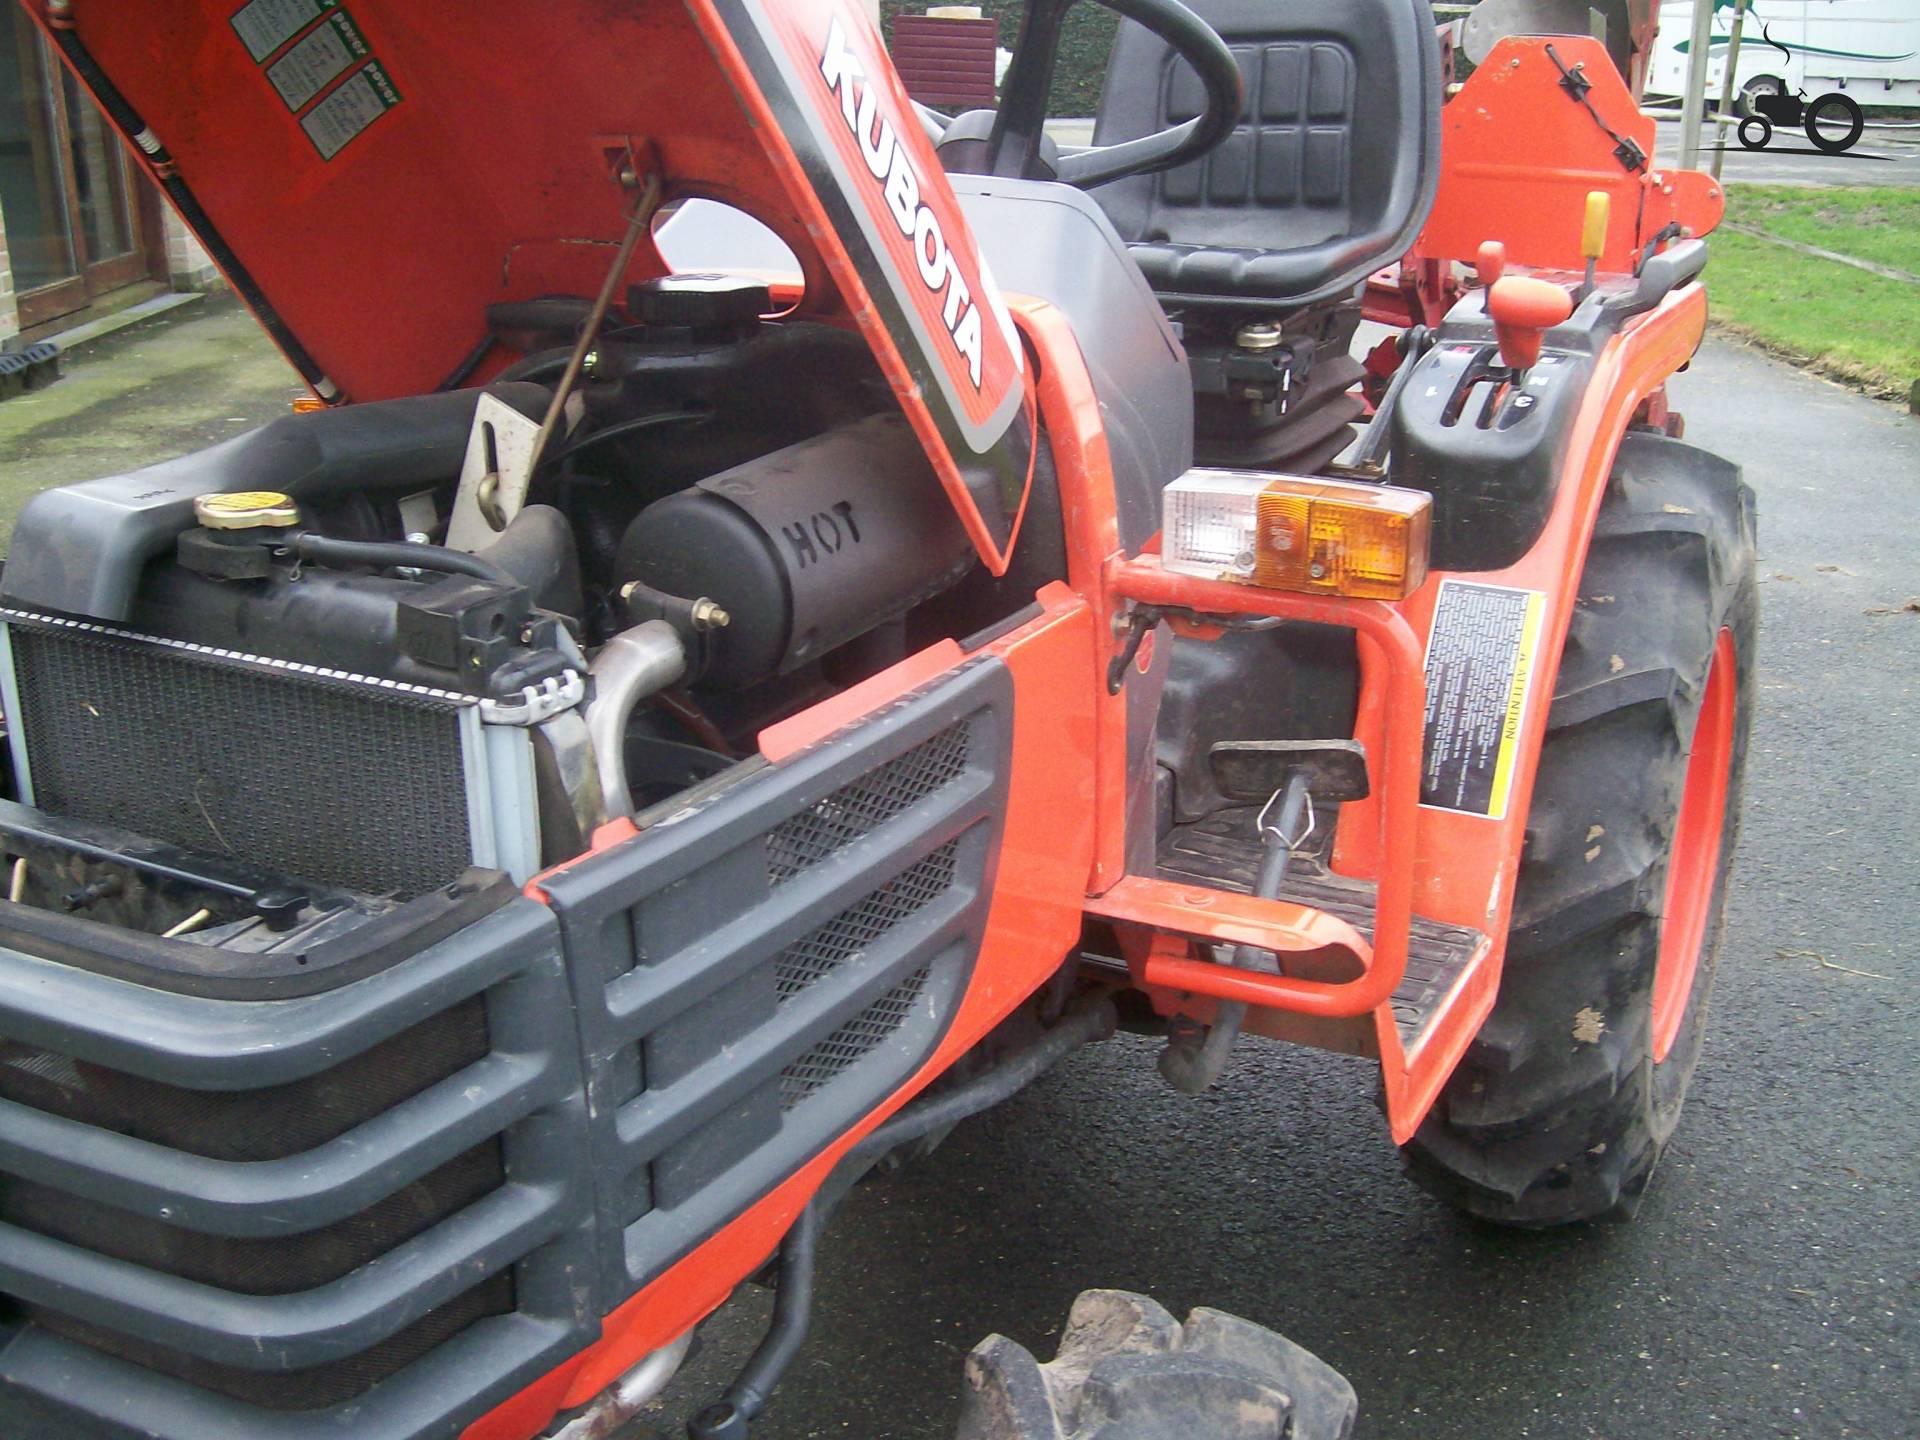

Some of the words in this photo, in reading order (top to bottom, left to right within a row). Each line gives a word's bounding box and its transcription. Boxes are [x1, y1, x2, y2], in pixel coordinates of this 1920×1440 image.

[820, 18, 983, 392] KUBOTA
[782, 501, 860, 569] HOT
[1505, 668, 1526, 740] ATTENTION
